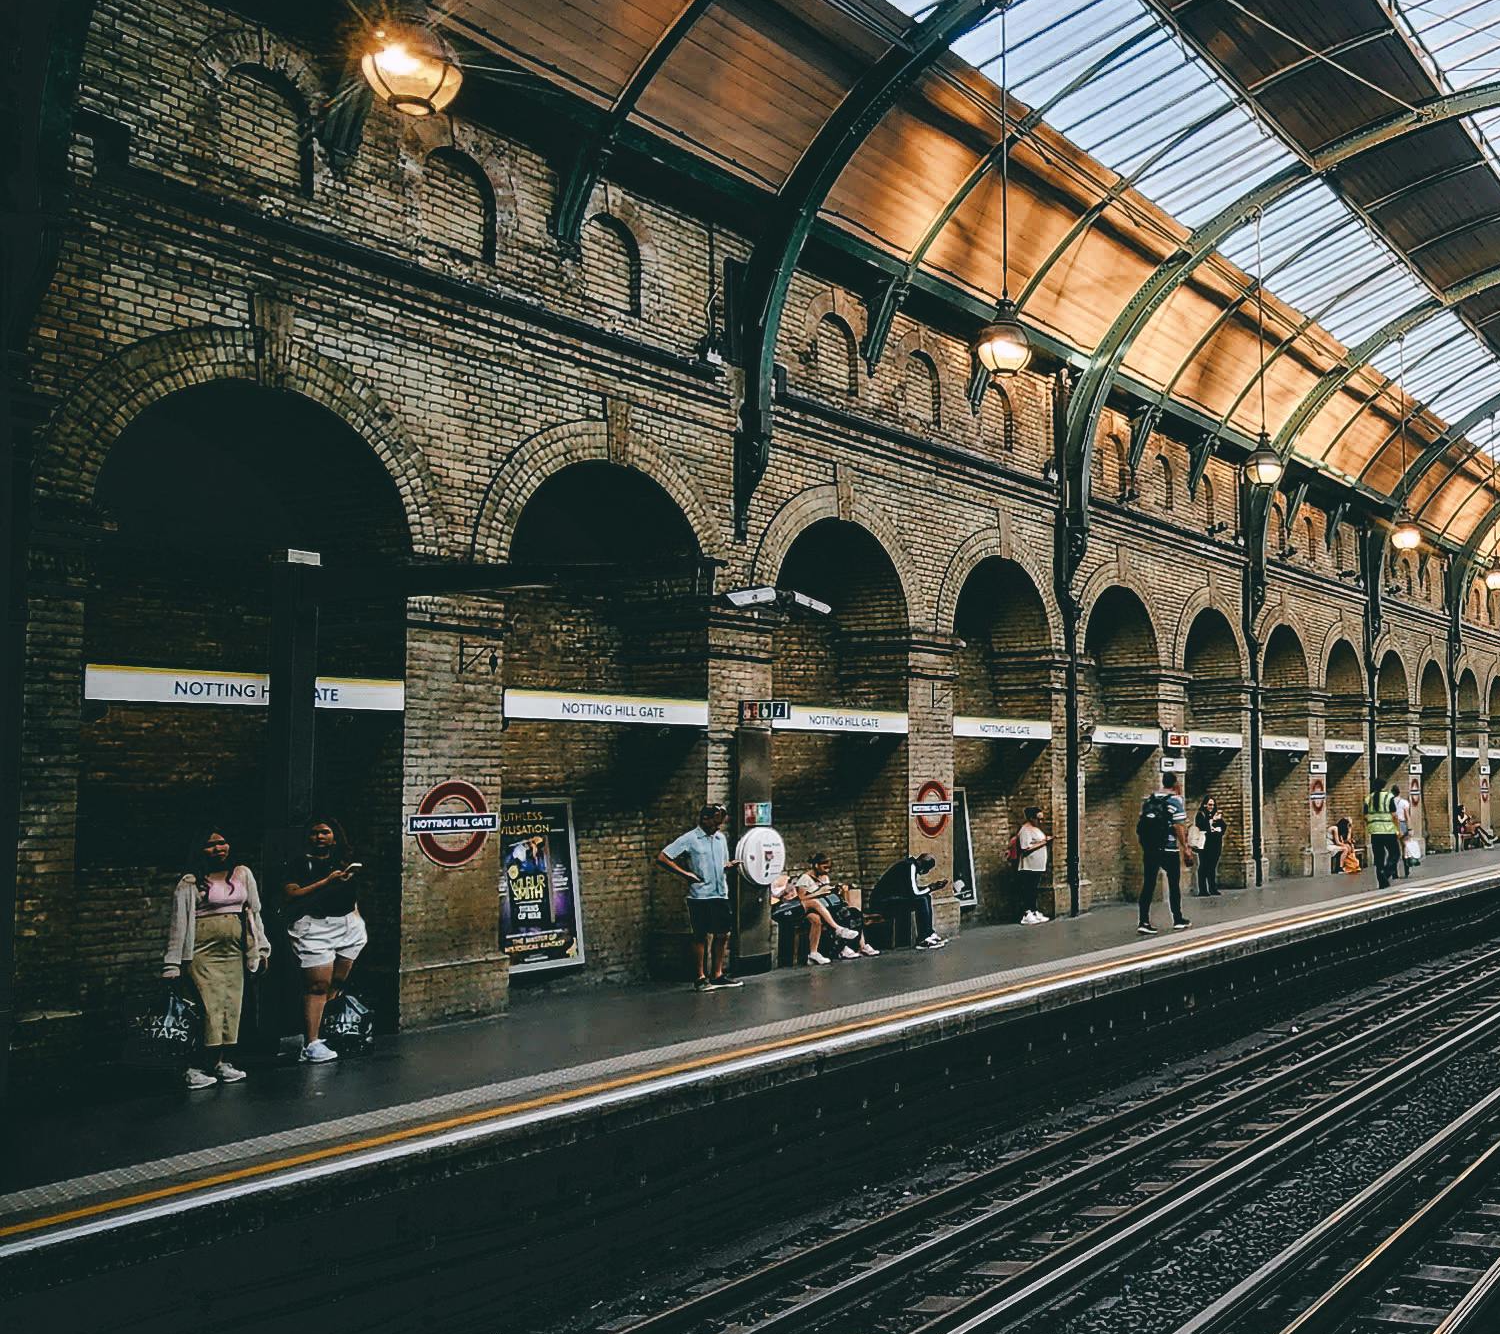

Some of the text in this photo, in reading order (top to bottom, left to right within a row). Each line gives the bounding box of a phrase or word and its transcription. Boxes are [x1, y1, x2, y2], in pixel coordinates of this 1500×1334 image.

[174, 680, 256, 698] NOTTING
[314, 687, 340, 702] ATE
[561, 702, 665, 718] NOTTING HILL GATE
[809, 715, 880, 728] NOTTING HILL GATE
[413, 817, 493, 829] NOTTING HILL GATE
[500, 811, 543, 822] UTHLESS
[513, 885, 544, 901] SMITH
